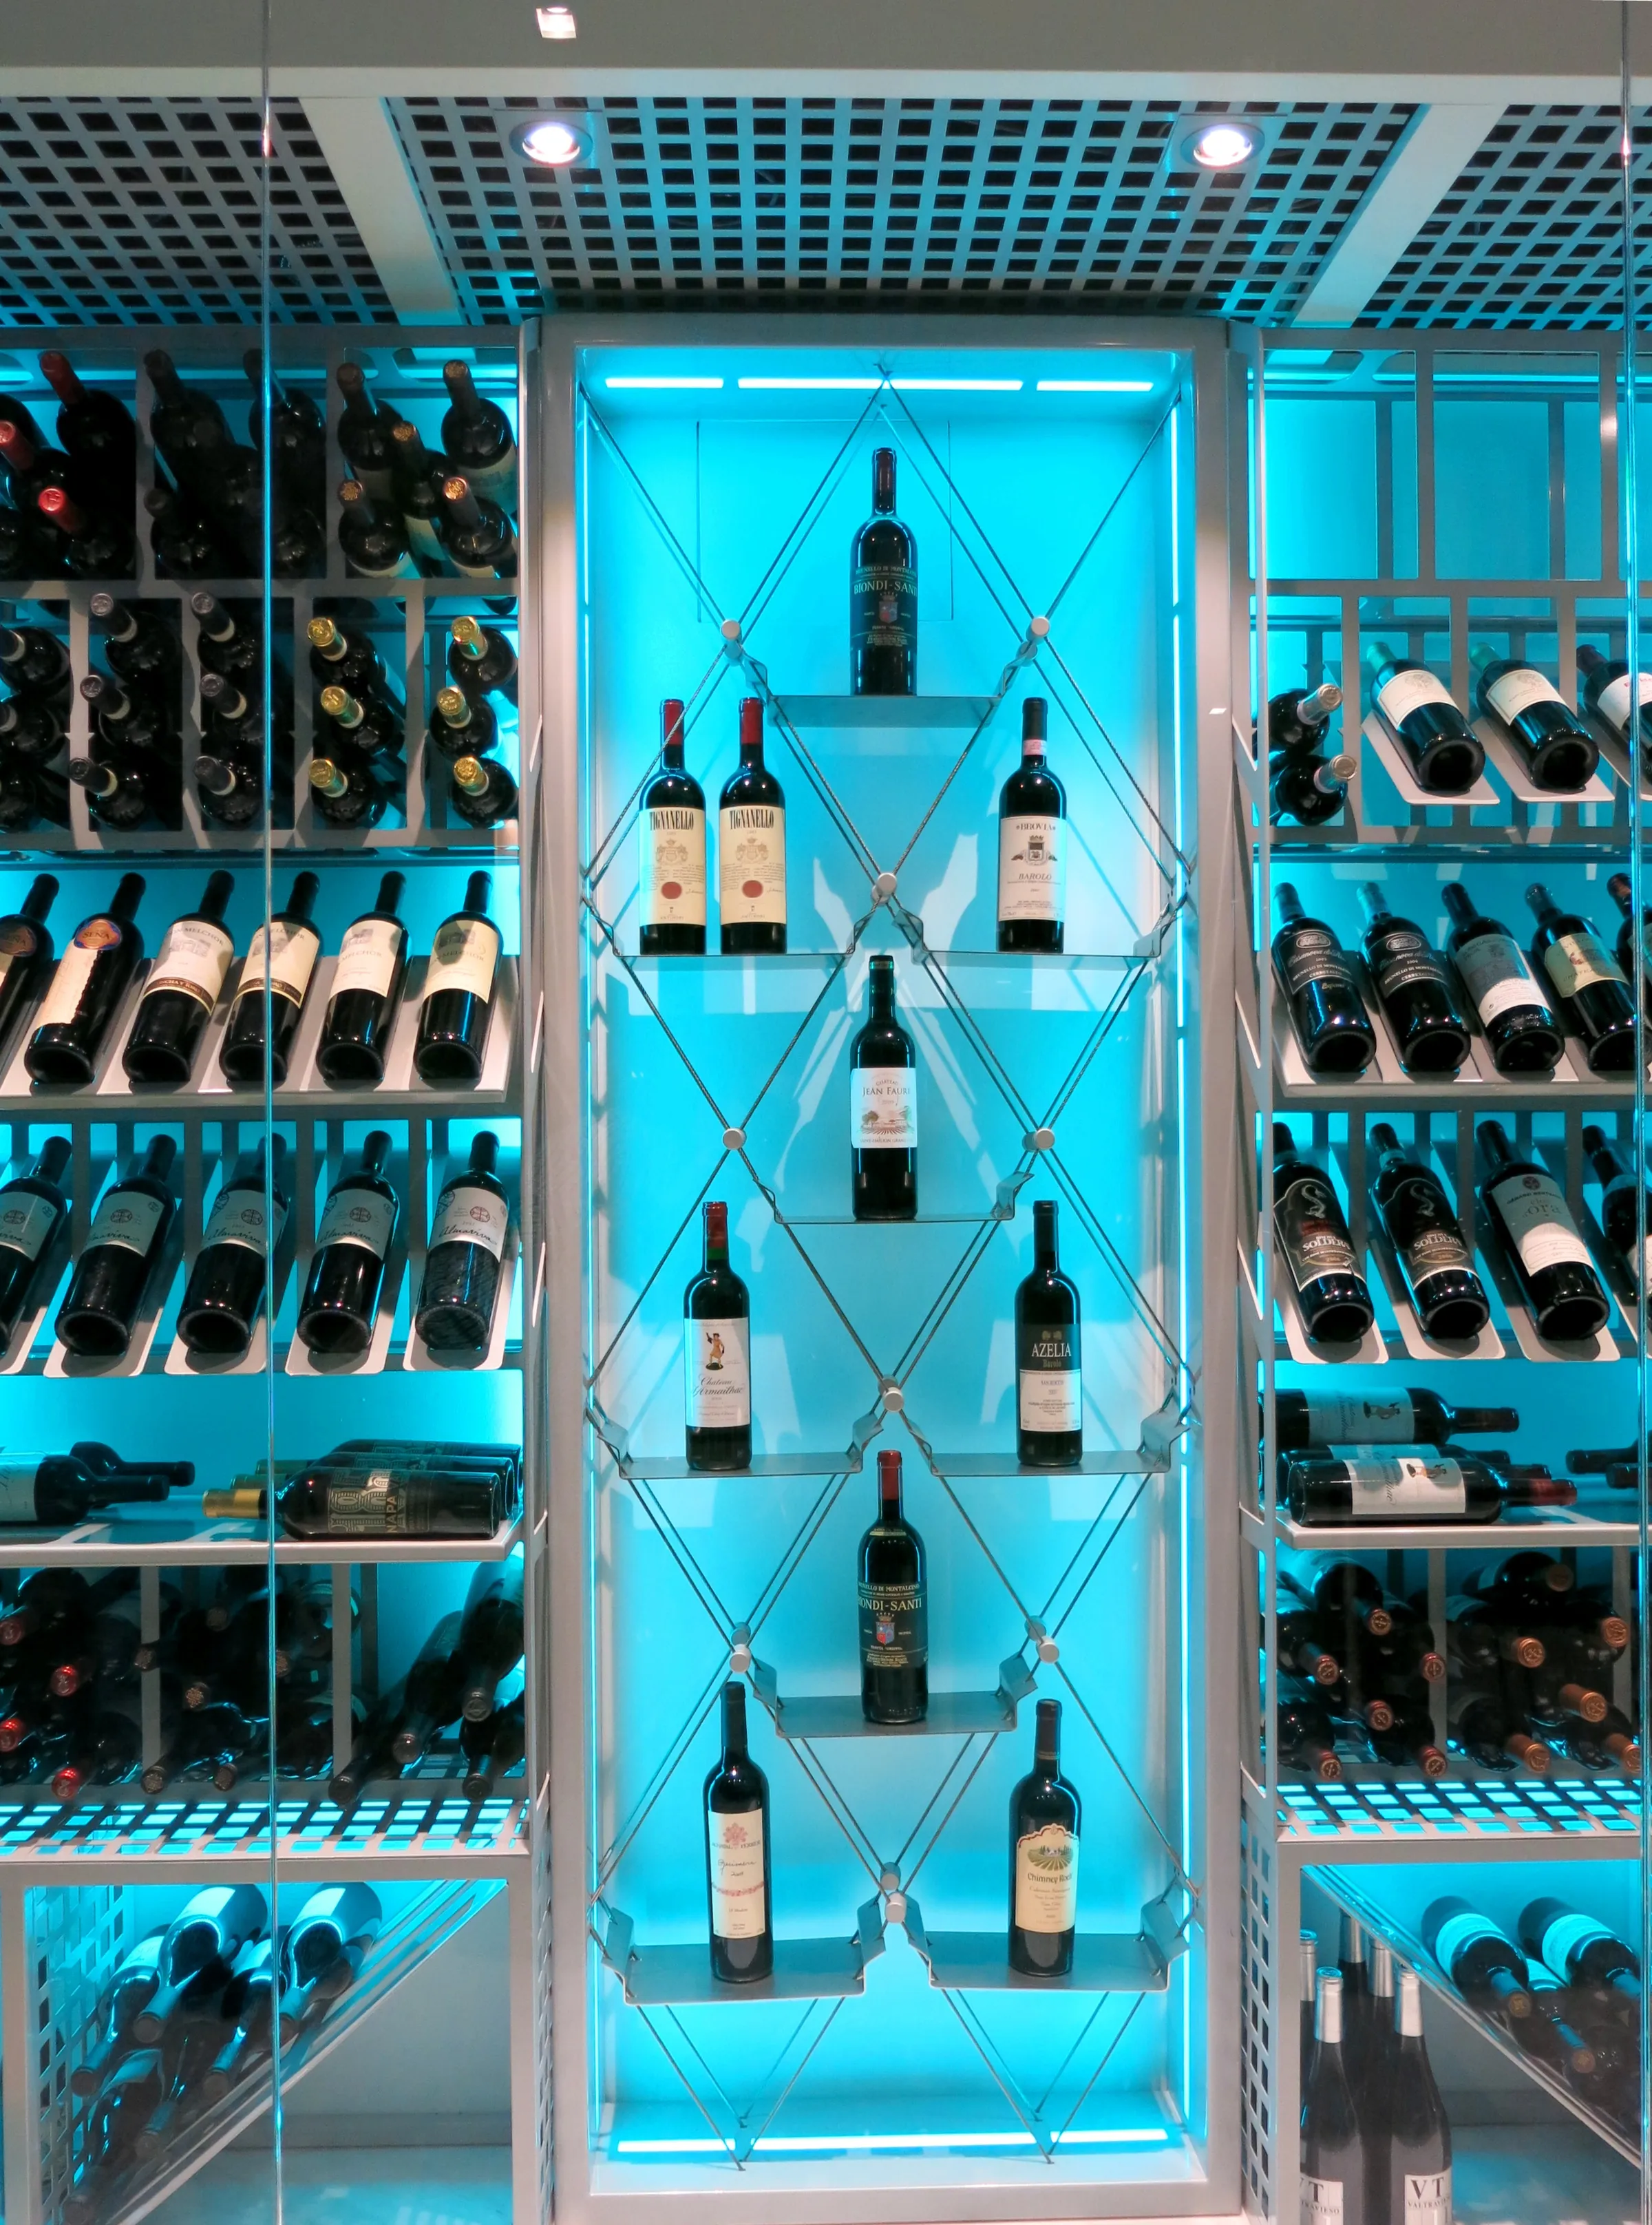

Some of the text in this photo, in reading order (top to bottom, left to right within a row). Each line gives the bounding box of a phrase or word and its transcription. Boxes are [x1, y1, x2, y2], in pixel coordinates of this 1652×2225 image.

[649, 810, 694, 831] TIGNANELLO
[730, 809, 774, 830] TIGNANELLO
[1020, 823, 1052, 831] BROVIA
[184, 927, 224, 947] MELCHOR
[862, 1087, 883, 1097] JEAN
[1031, 1342, 1072, 1358] AZELIA
[1043, 1359, 1062, 1369] Barolo
[386, 1495, 398, 1533] NAPA
[885, 1583, 920, 1592] MONTALCINO
[1027, 1872, 1058, 1884] Chimney
